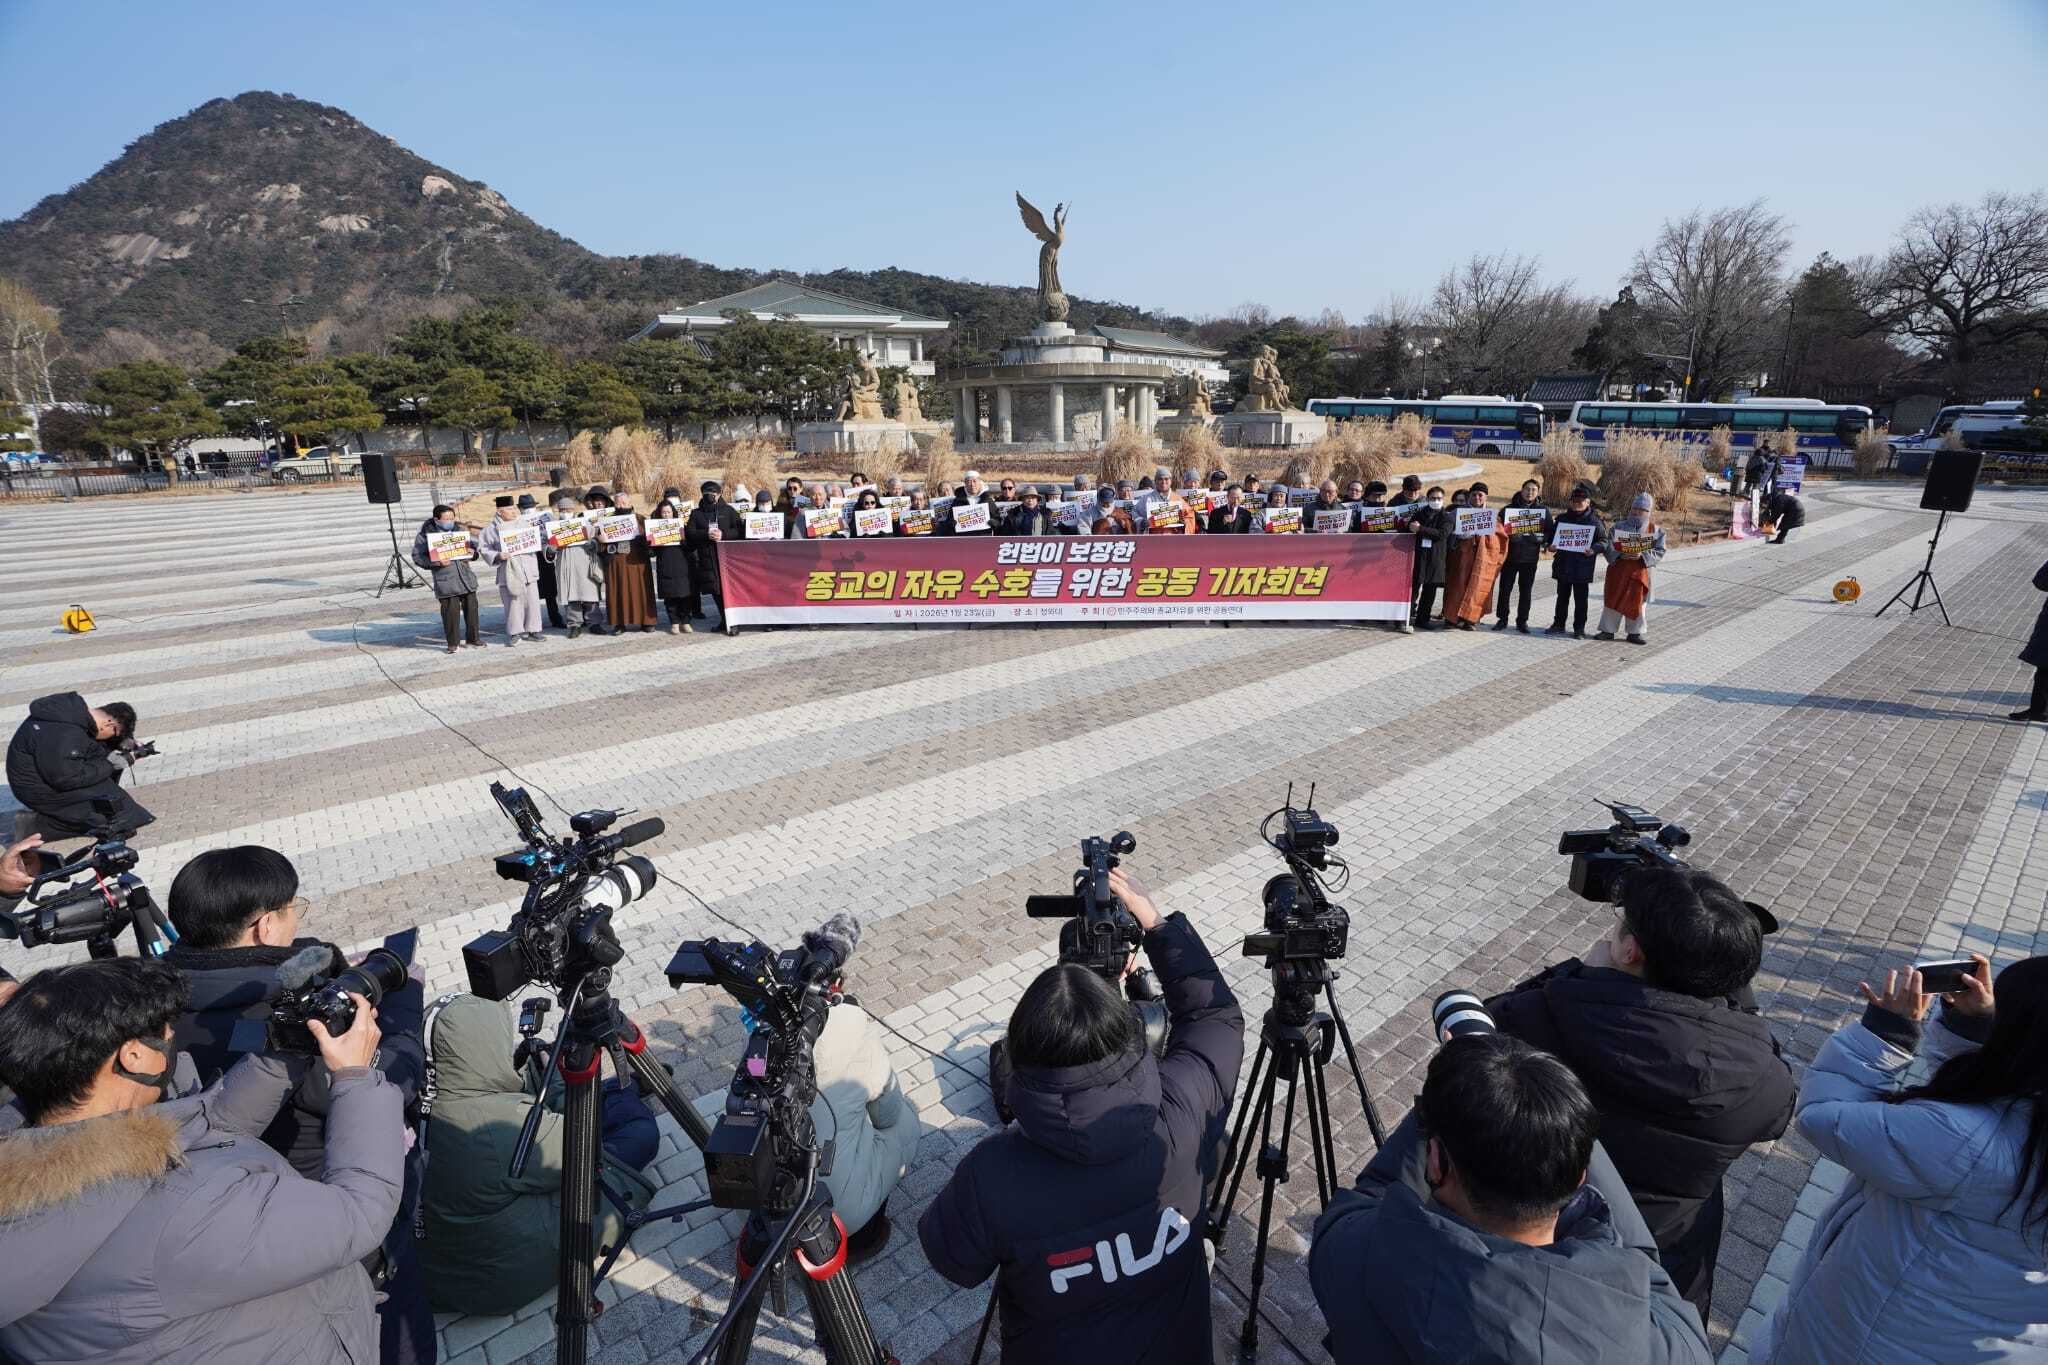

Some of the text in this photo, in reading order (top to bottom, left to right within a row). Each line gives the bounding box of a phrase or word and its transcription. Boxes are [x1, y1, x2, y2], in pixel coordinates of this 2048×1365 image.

[998, 540, 1136, 564] 헌법이 보장한
[804, 565, 1329, 601] 종교의 자유 수호를 위한 공동 기자회견
[1046, 1206, 1190, 1294] FILA
